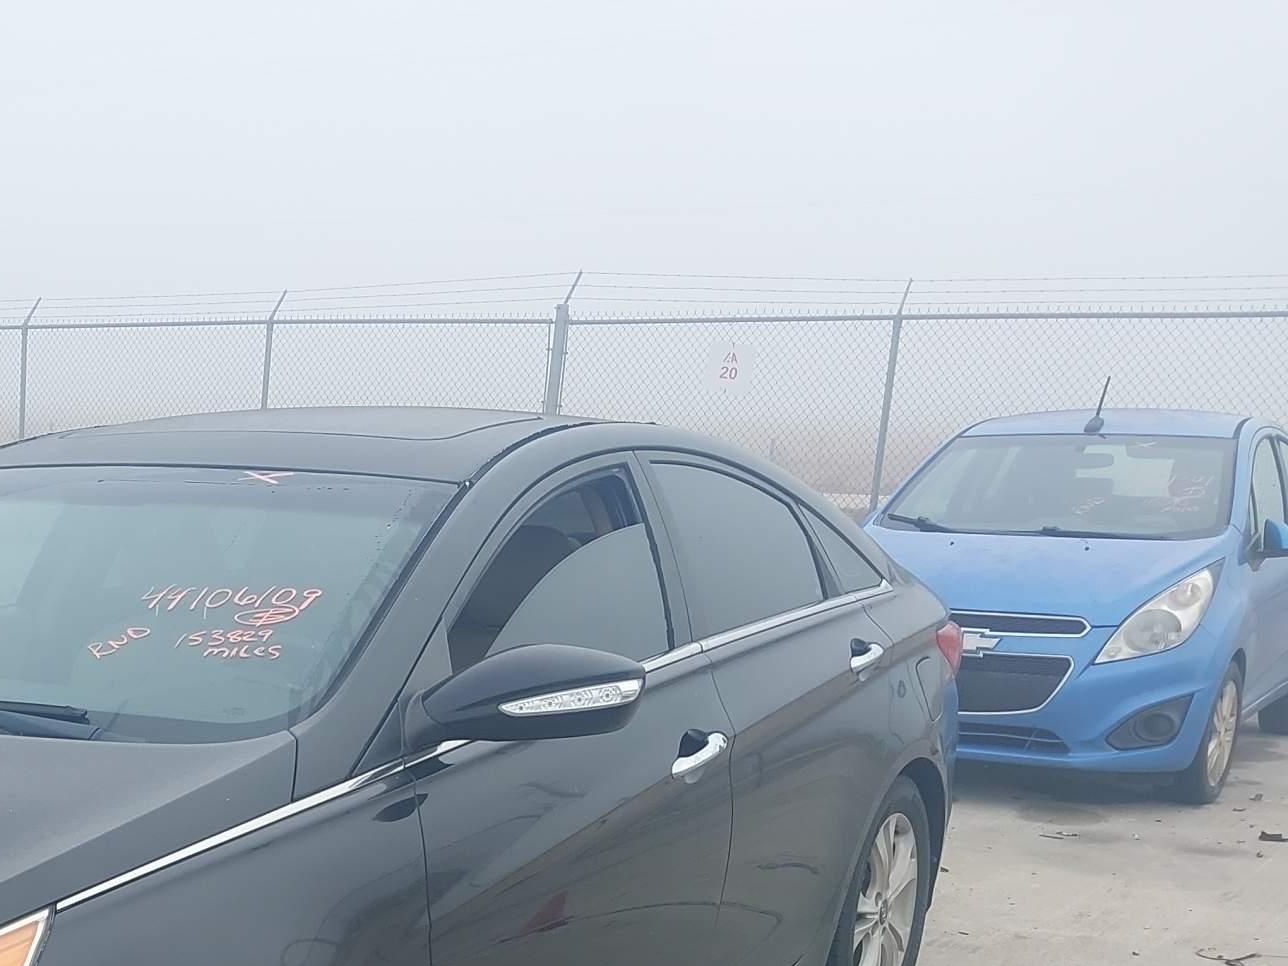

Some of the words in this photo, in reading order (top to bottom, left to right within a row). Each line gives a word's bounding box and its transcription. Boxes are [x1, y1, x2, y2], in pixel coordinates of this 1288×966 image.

[719, 366, 738, 380] 20
[141, 584, 323, 612] 44106109
[174, 629, 274, 648] 153829
